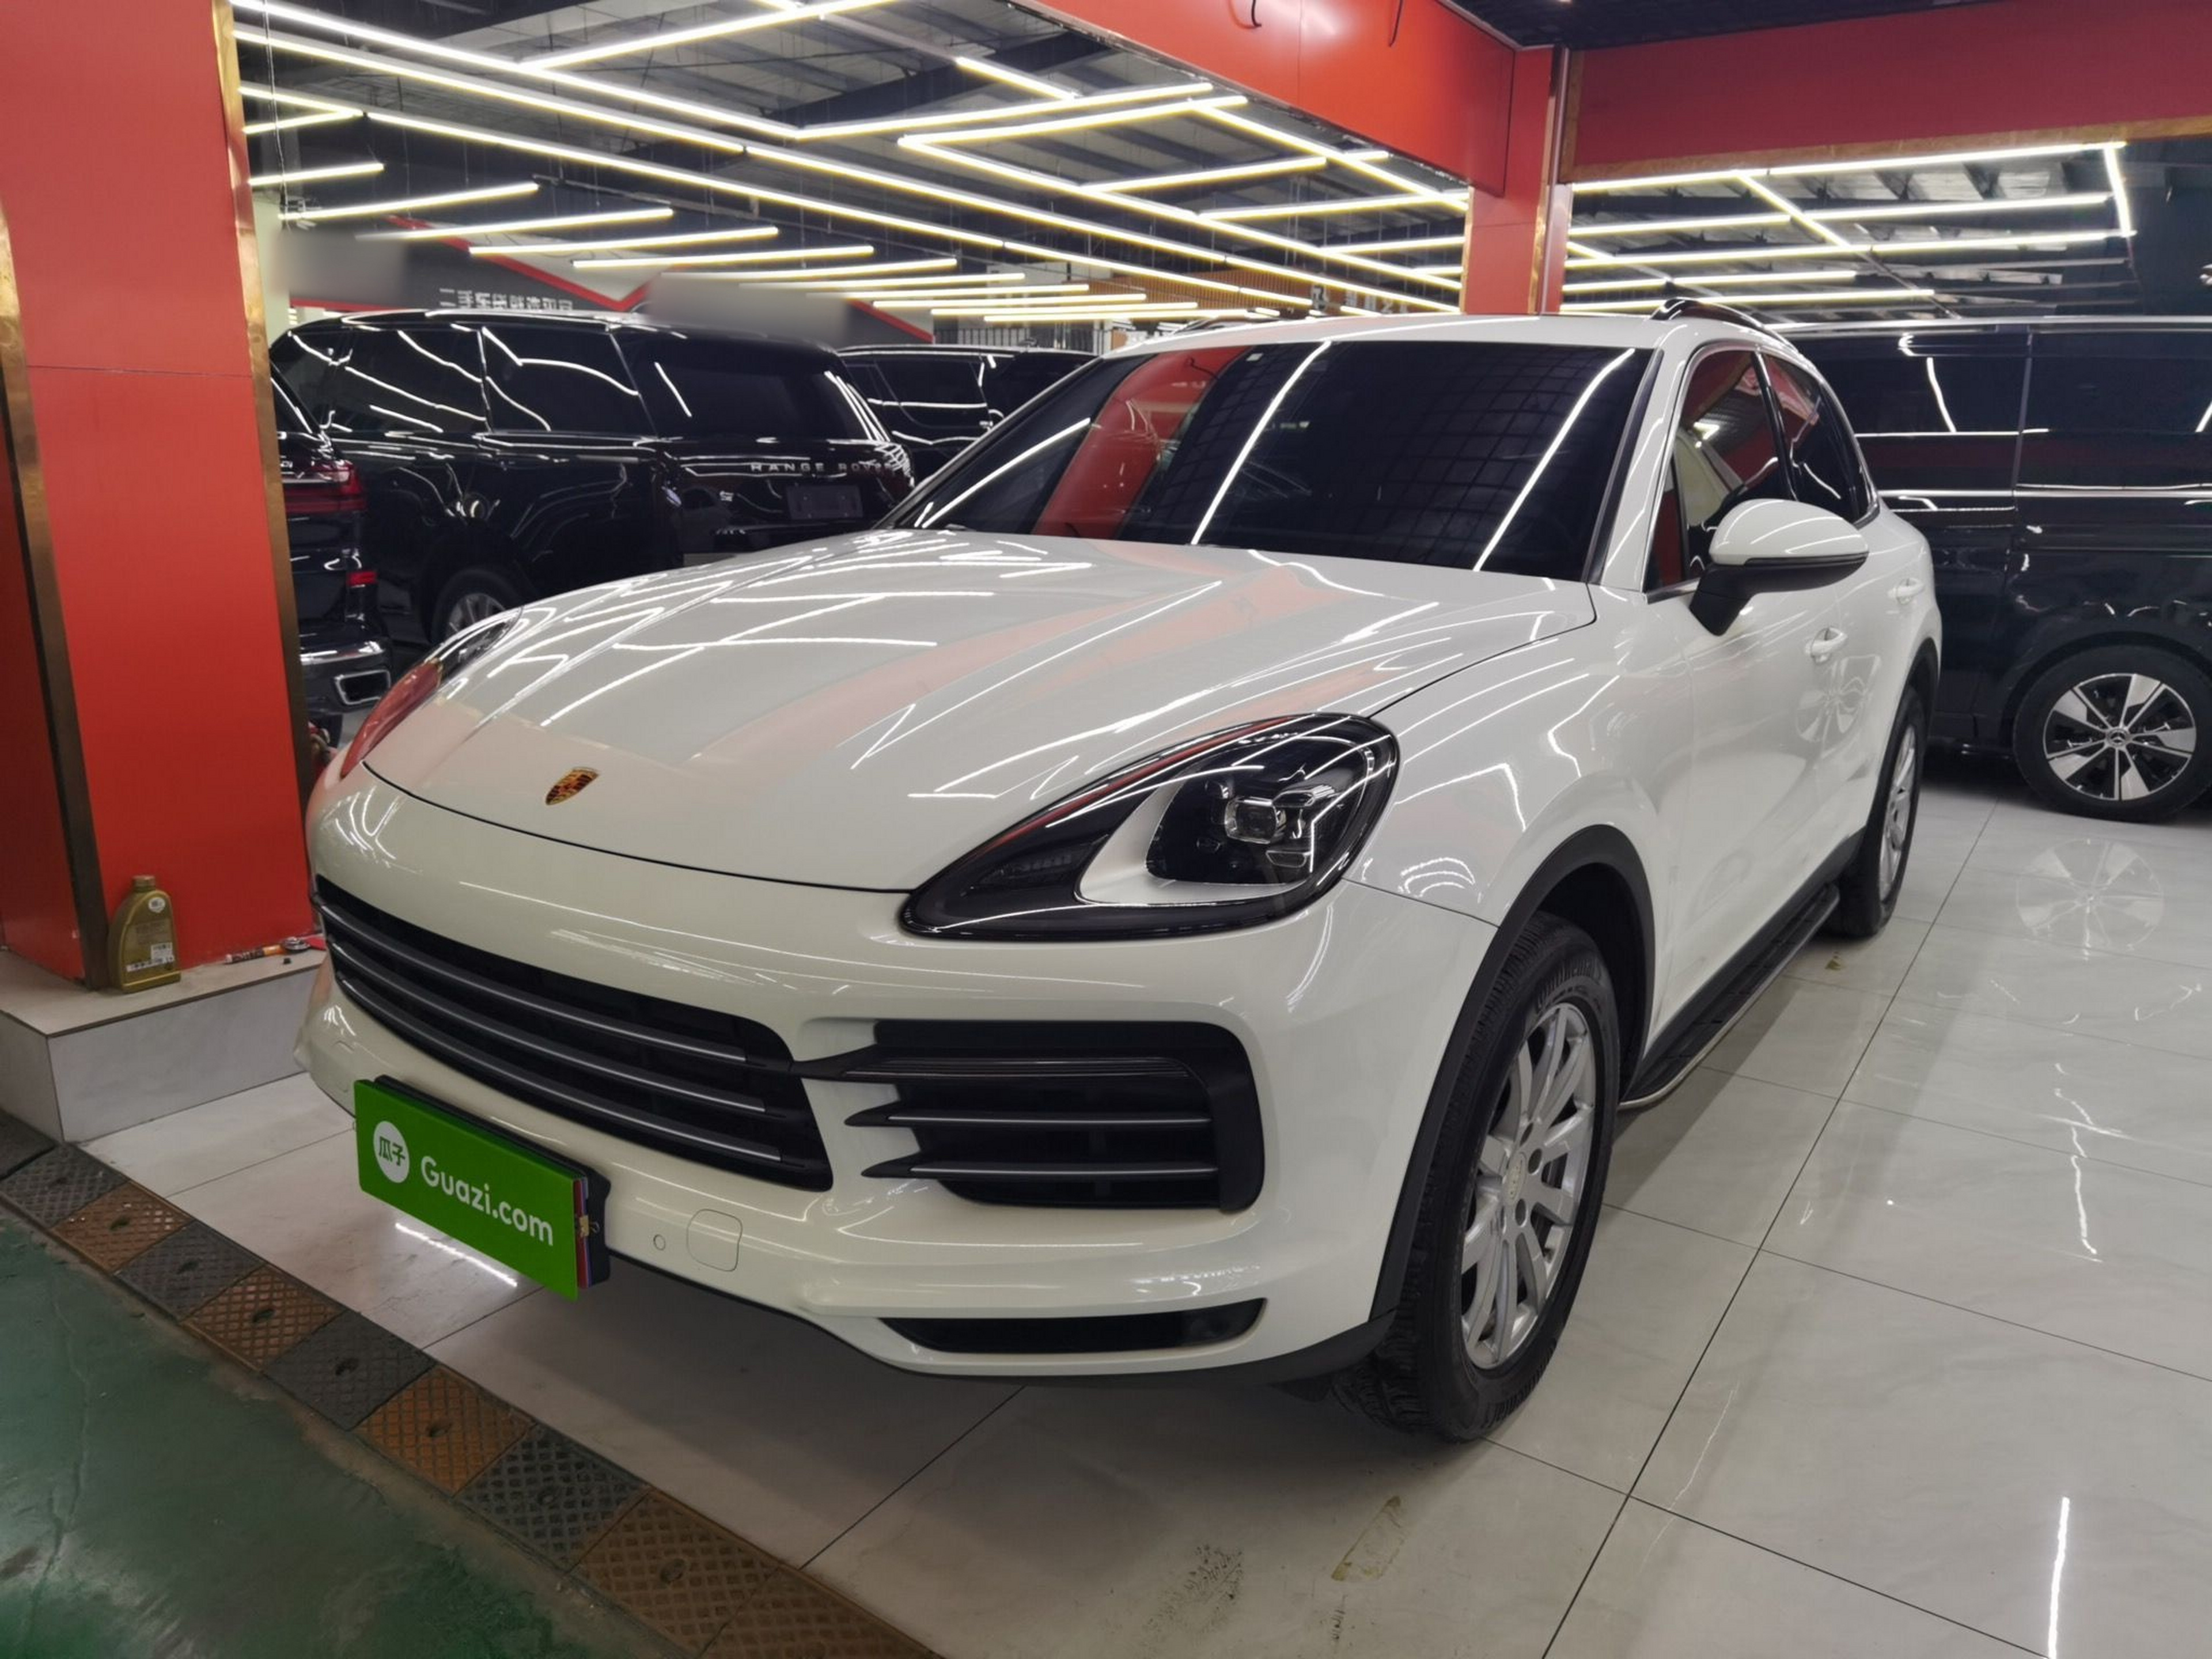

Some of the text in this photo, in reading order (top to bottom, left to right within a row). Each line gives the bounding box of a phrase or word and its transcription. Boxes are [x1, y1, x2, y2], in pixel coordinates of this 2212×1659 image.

[751, 463, 824, 472] RANGE
[379, 1136, 406, 1166] 瓜子
[421, 1156, 553, 1246] Guazi.com
